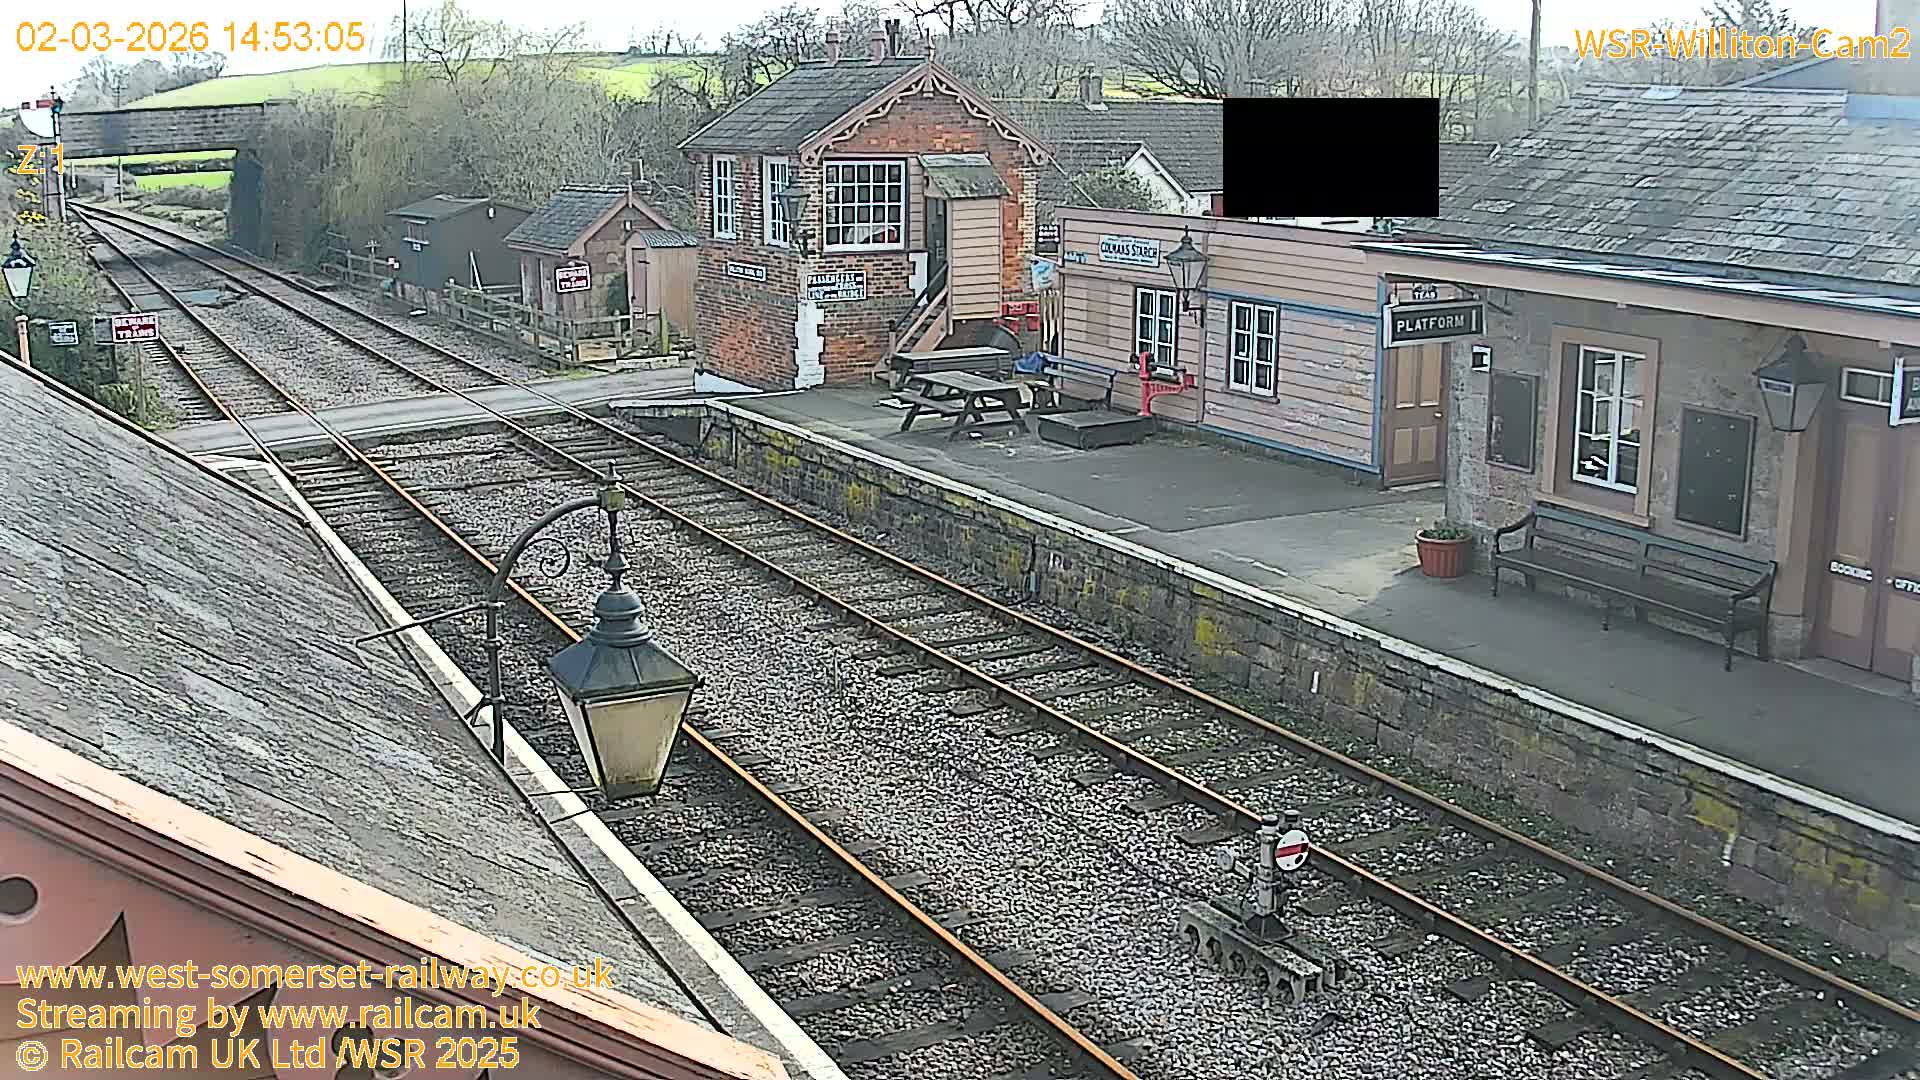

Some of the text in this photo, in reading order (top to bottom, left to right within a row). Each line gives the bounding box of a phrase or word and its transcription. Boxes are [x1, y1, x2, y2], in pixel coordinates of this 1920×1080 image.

[808, 273, 855, 285] PASSENGERS
[113, 316, 155, 327] BEWARE
[1396, 309, 1477, 333] PLATFORM 1
[117, 328, 155, 338] TRAINS
[1830, 561, 1873, 581] BOOKING
